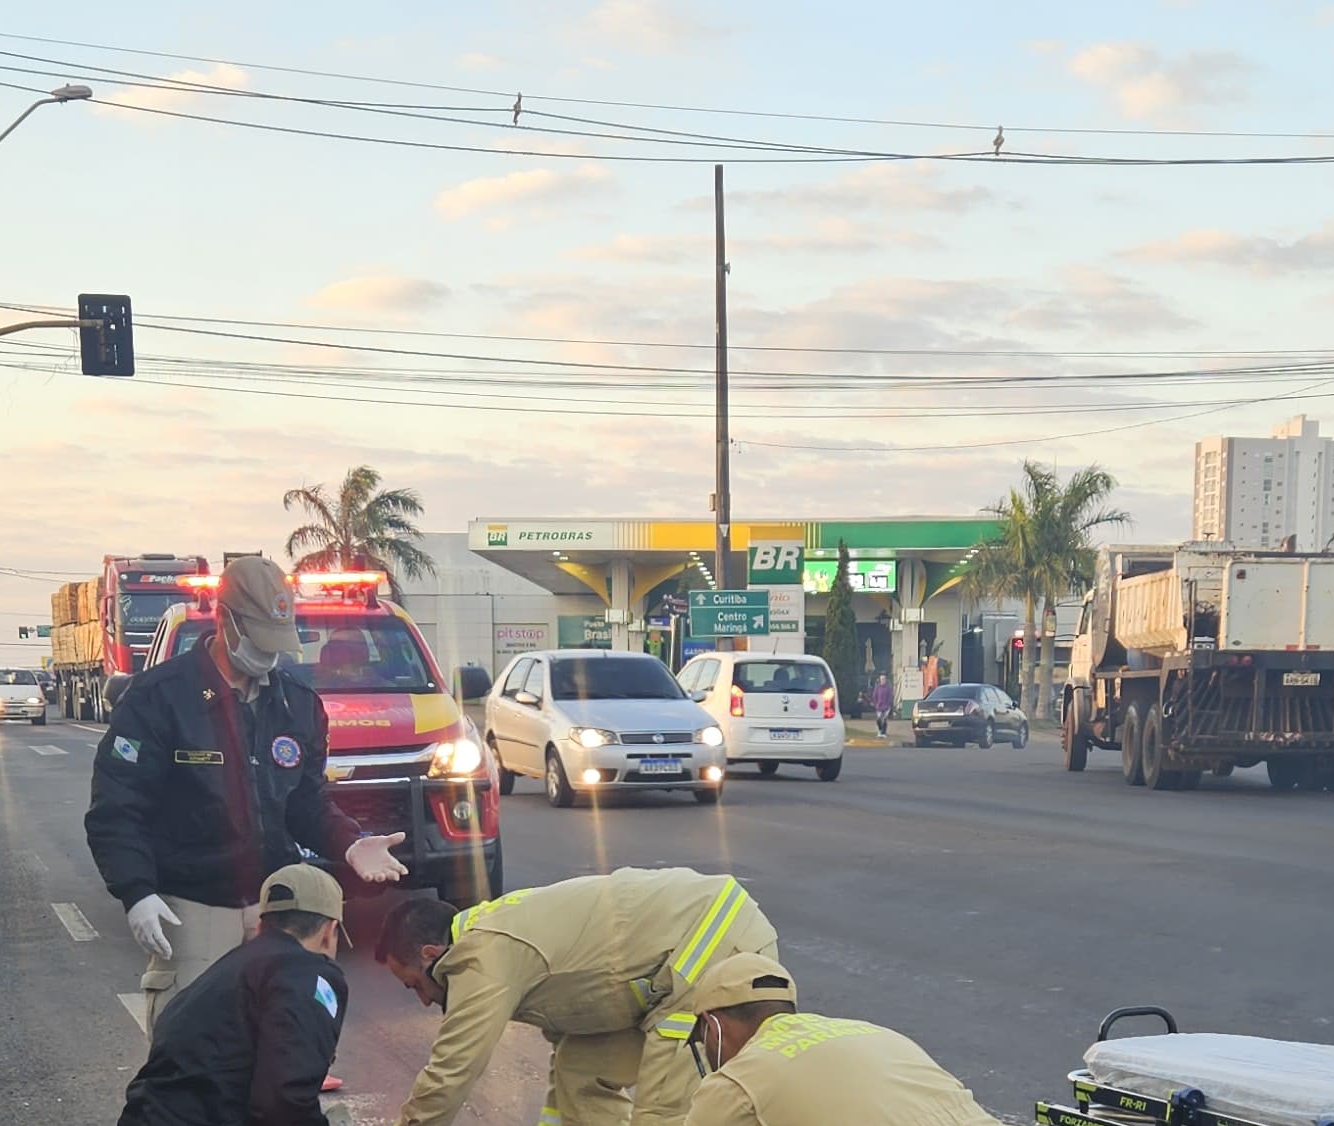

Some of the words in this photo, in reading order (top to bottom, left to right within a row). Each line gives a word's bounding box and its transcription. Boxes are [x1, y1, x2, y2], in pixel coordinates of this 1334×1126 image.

[488, 532, 507, 541] BR
[519, 532, 593, 540] PETROBRAS
[752, 546, 800, 570] BR
[713, 594, 747, 604] Curitiba
[717, 612, 747, 622] Centro
[714, 622, 747, 634] Maringá
